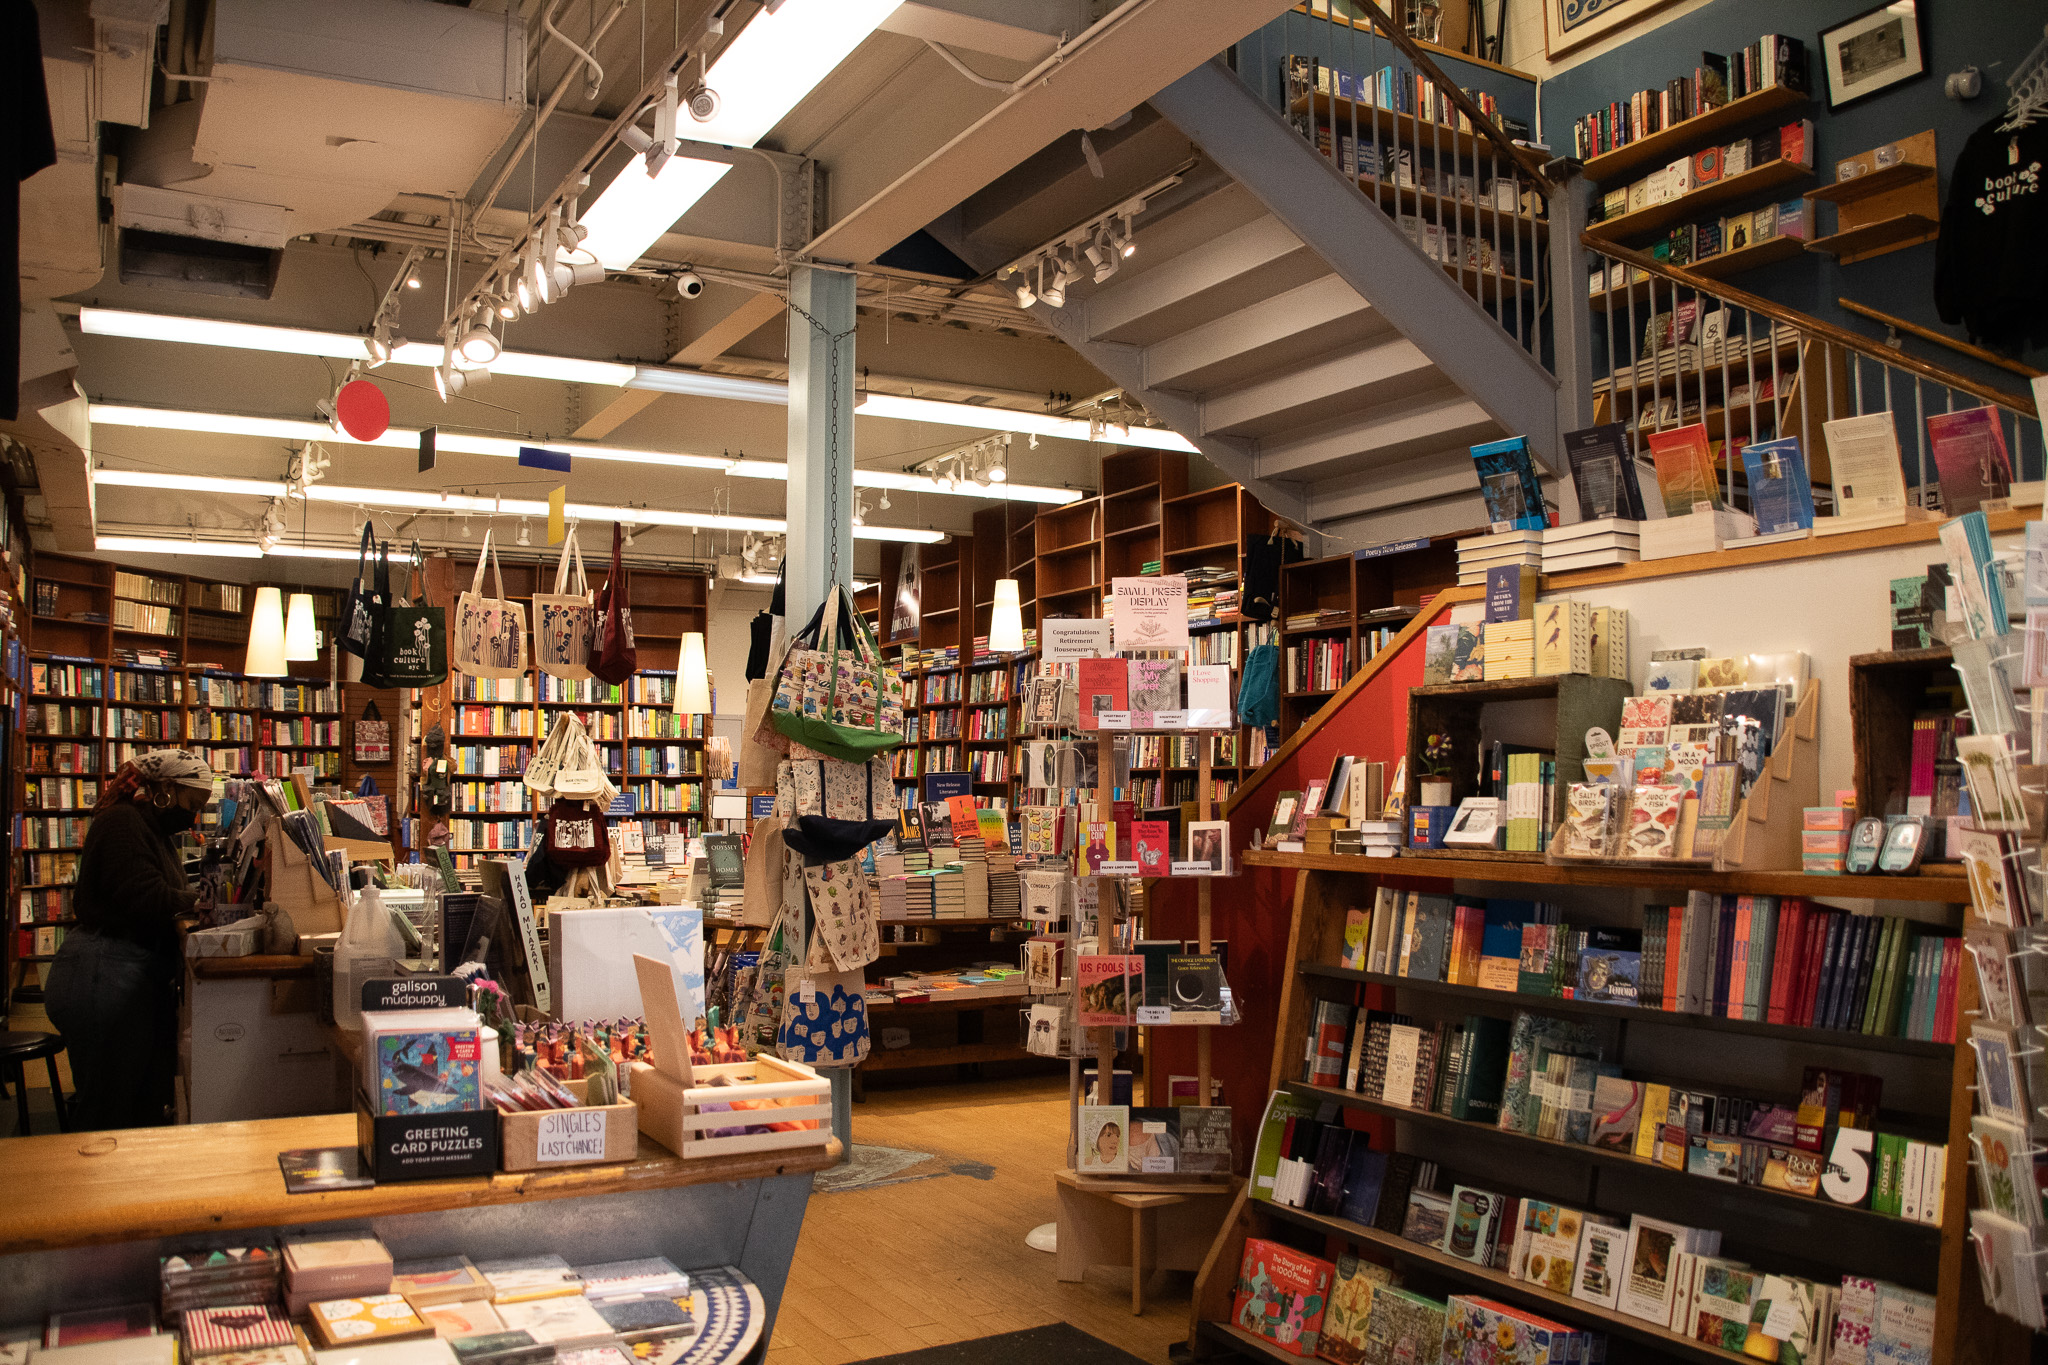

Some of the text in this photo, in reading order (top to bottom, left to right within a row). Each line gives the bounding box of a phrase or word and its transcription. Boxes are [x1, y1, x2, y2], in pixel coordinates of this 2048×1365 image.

[1117, 586, 1182, 596] SMALL PRESS
[1130, 597, 1170, 607] DISPLAY
[1052, 629, 1100, 637] Congratulations
[1059, 637, 1093, 645] Retirement
[400, 647, 418, 657] book
[393, 656, 426, 664] culture
[1130, 661, 1167, 671] Outline
[1144, 671, 1160, 682] My
[1192, 676, 1220, 684] Shopping
[1130, 682, 1160, 691] Lover
[1589, 740, 1609, 749] SPROUT
[622, 822, 642, 831] ON AIR
[899, 809, 922, 840] JAMES
[1086, 823, 1108, 832] HOLLOW
[1028, 809, 1053, 852] GREAT WORK
[1090, 831, 1104, 840] COIN
[514, 874, 539, 972] HAYAO MIYAZAKI
[1080, 962, 1124, 973] US FOOLS
[392, 980, 438, 996] galison
[1608, 984, 1638, 997] TOTORO
[381, 993, 447, 1007] mudpuppy
[546, 1113, 602, 1134] SINGLES
[405, 1126, 469, 1141] GREETING
[390, 1137, 483, 1155] CARD PUZZLES
[541, 1137, 603, 1156] LAST CHANCE!
[446, 1154, 473, 1162] MESSAGE!
[1820, 1126, 1874, 1204] 5
[1882, 1154, 1891, 1196] JOKES
[1590, 1225, 1621, 1240] BIBLIOPHILE
[1272, 1253, 1312, 1276] The Story of Art
[1270, 1263, 1310, 1286] in 1000 Pieces
[1902, 1304, 1915, 1315] 40
